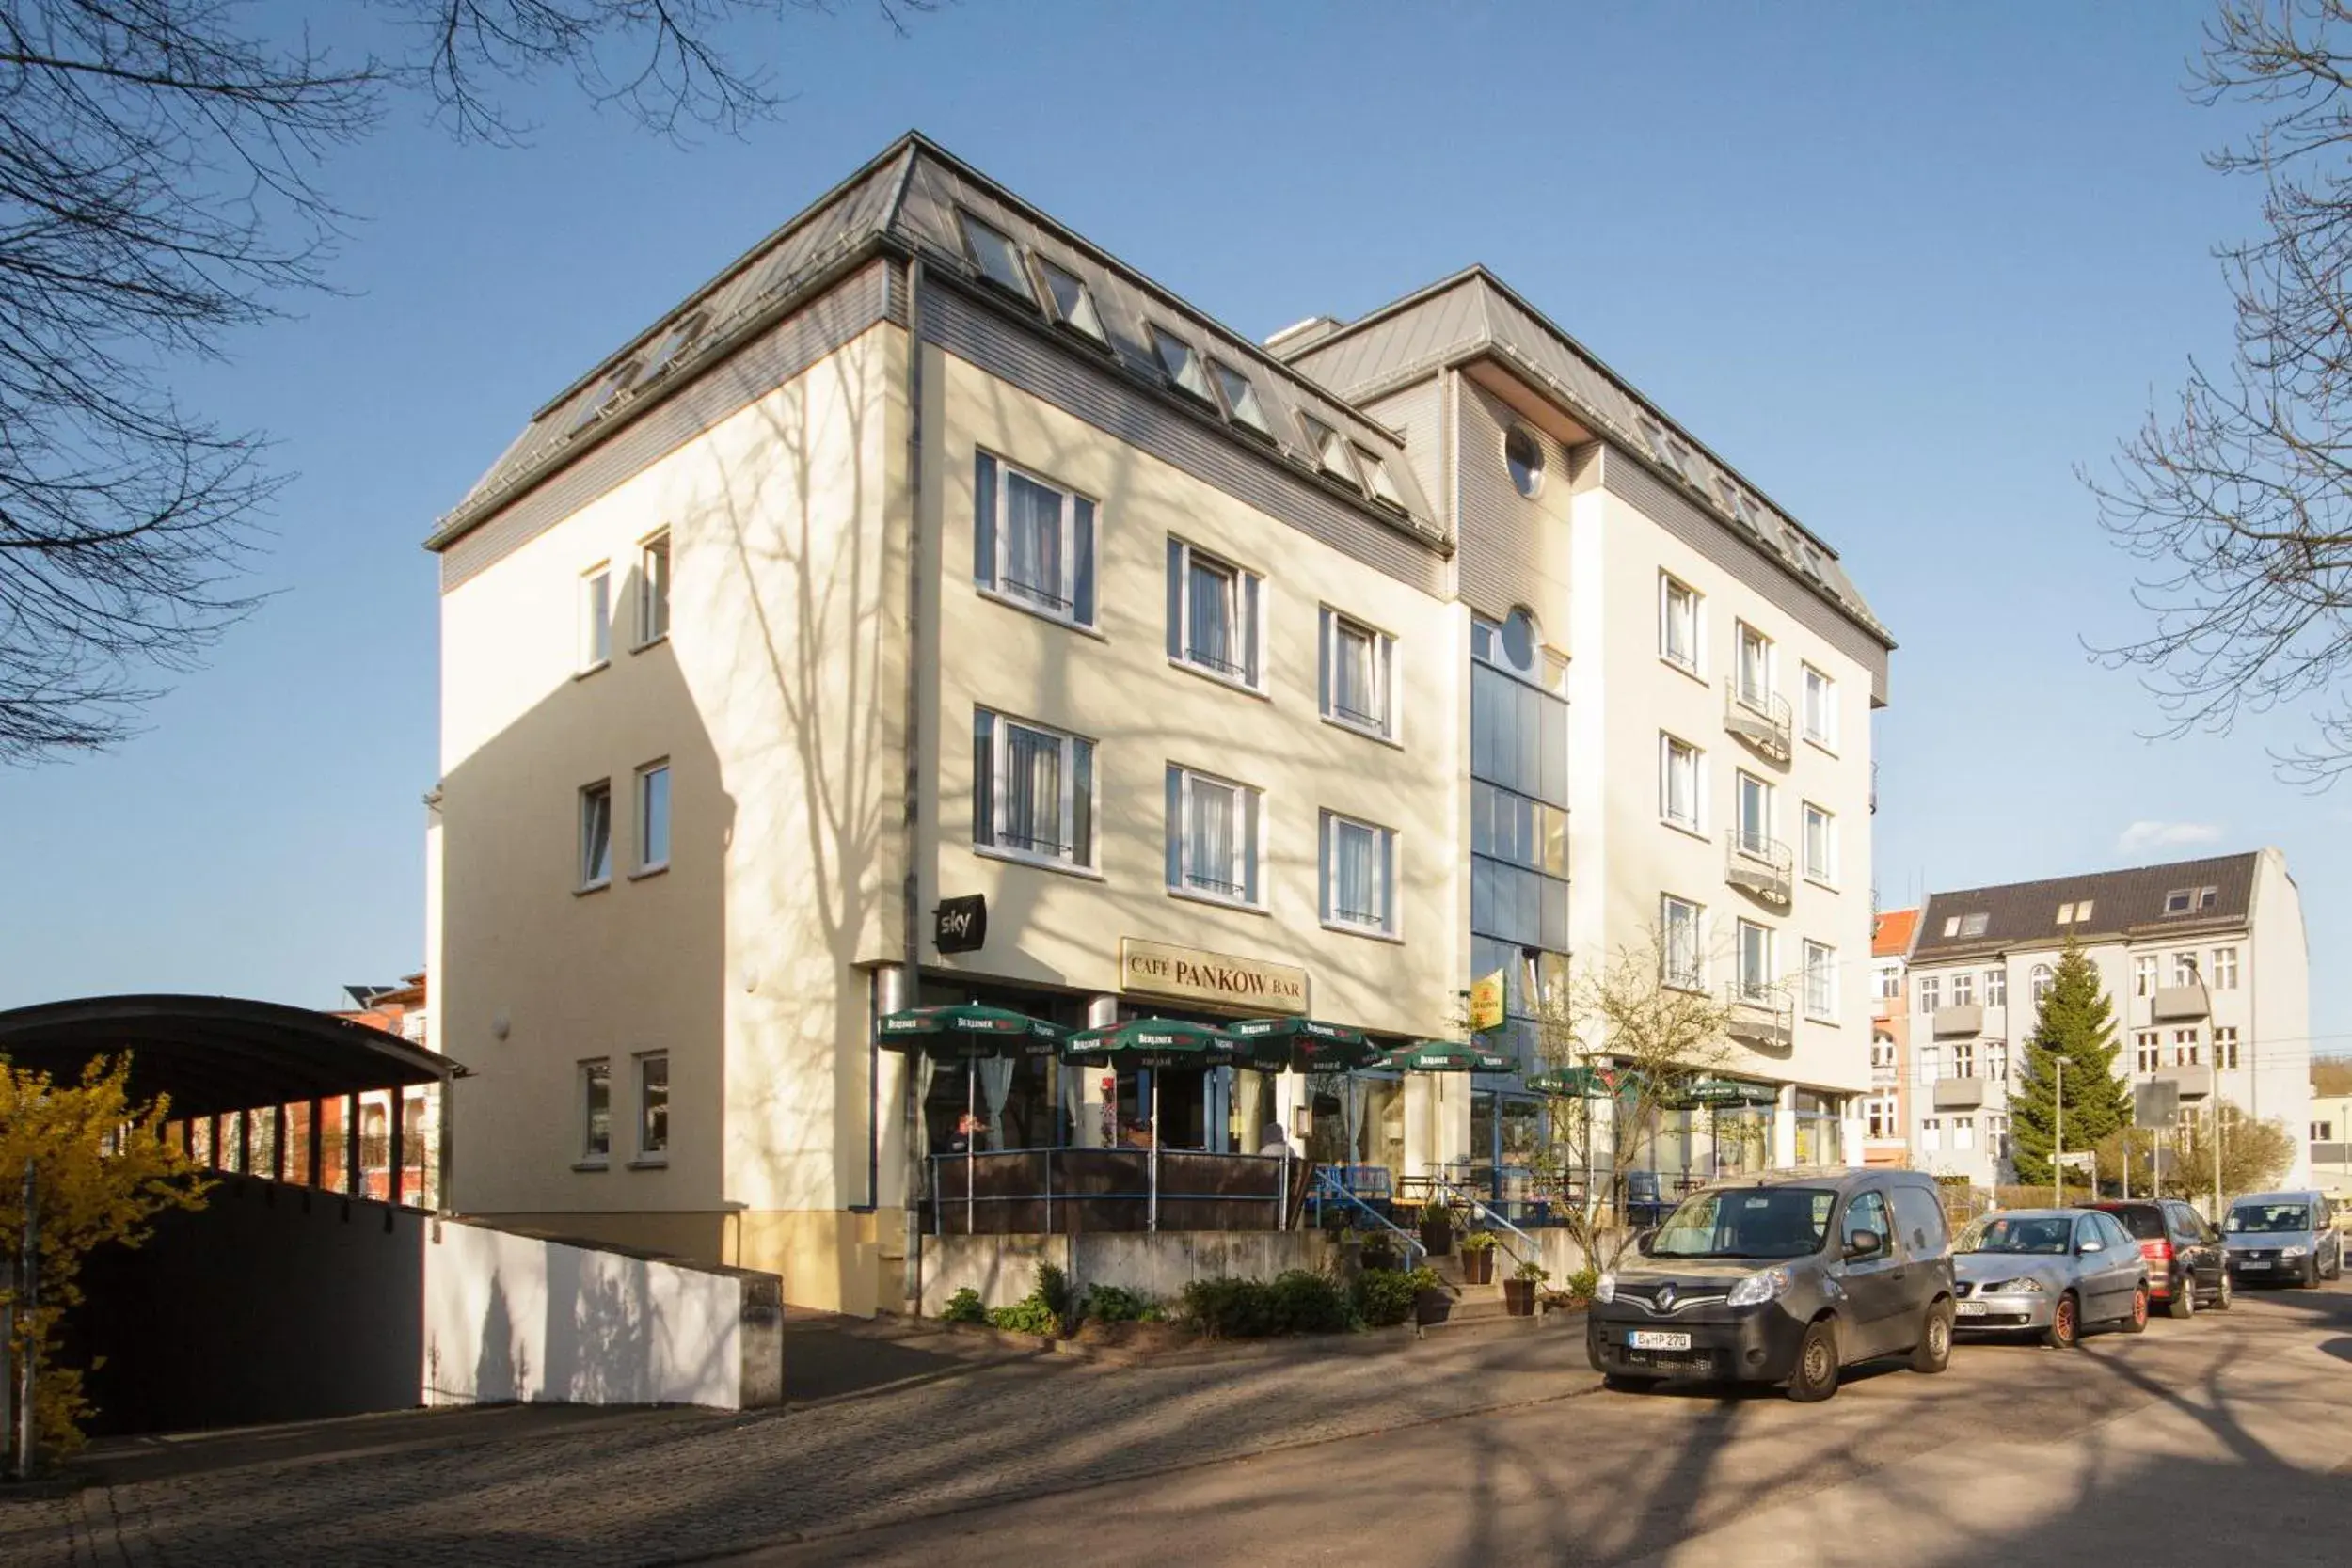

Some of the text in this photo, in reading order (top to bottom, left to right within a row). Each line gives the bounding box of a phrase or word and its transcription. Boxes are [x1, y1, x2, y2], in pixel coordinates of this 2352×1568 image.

[941, 910, 971, 938] sky
[1176, 960, 1267, 994] PANKOW
[1272, 979, 1299, 997] BAR
